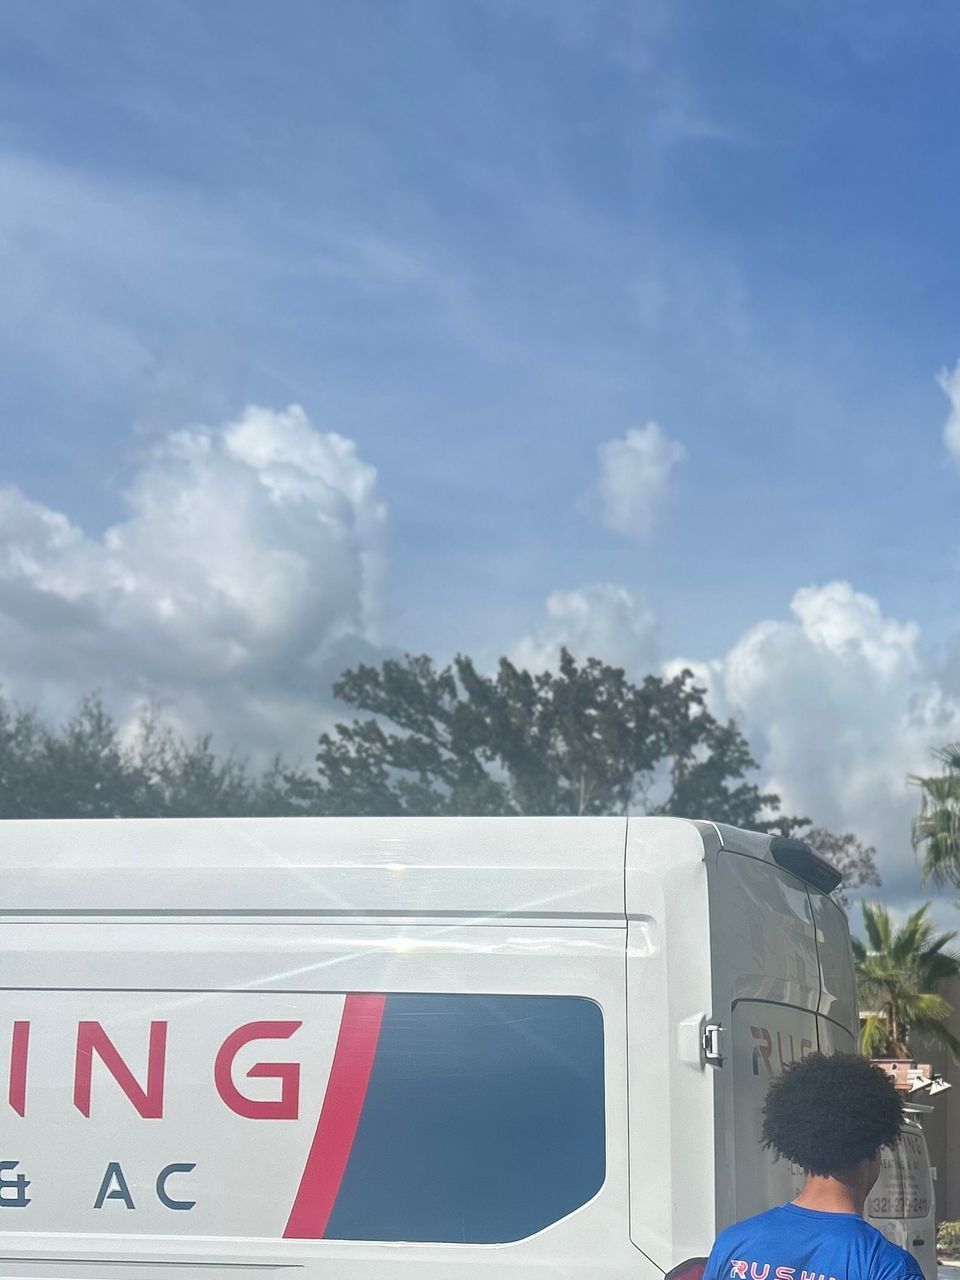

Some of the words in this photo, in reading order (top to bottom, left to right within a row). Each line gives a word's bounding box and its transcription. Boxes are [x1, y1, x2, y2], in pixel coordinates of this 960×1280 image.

[9, 1020, 303, 1120] ING
[0, 1161, 31, 1207] &
[94, 1162, 197, 1209] AC
